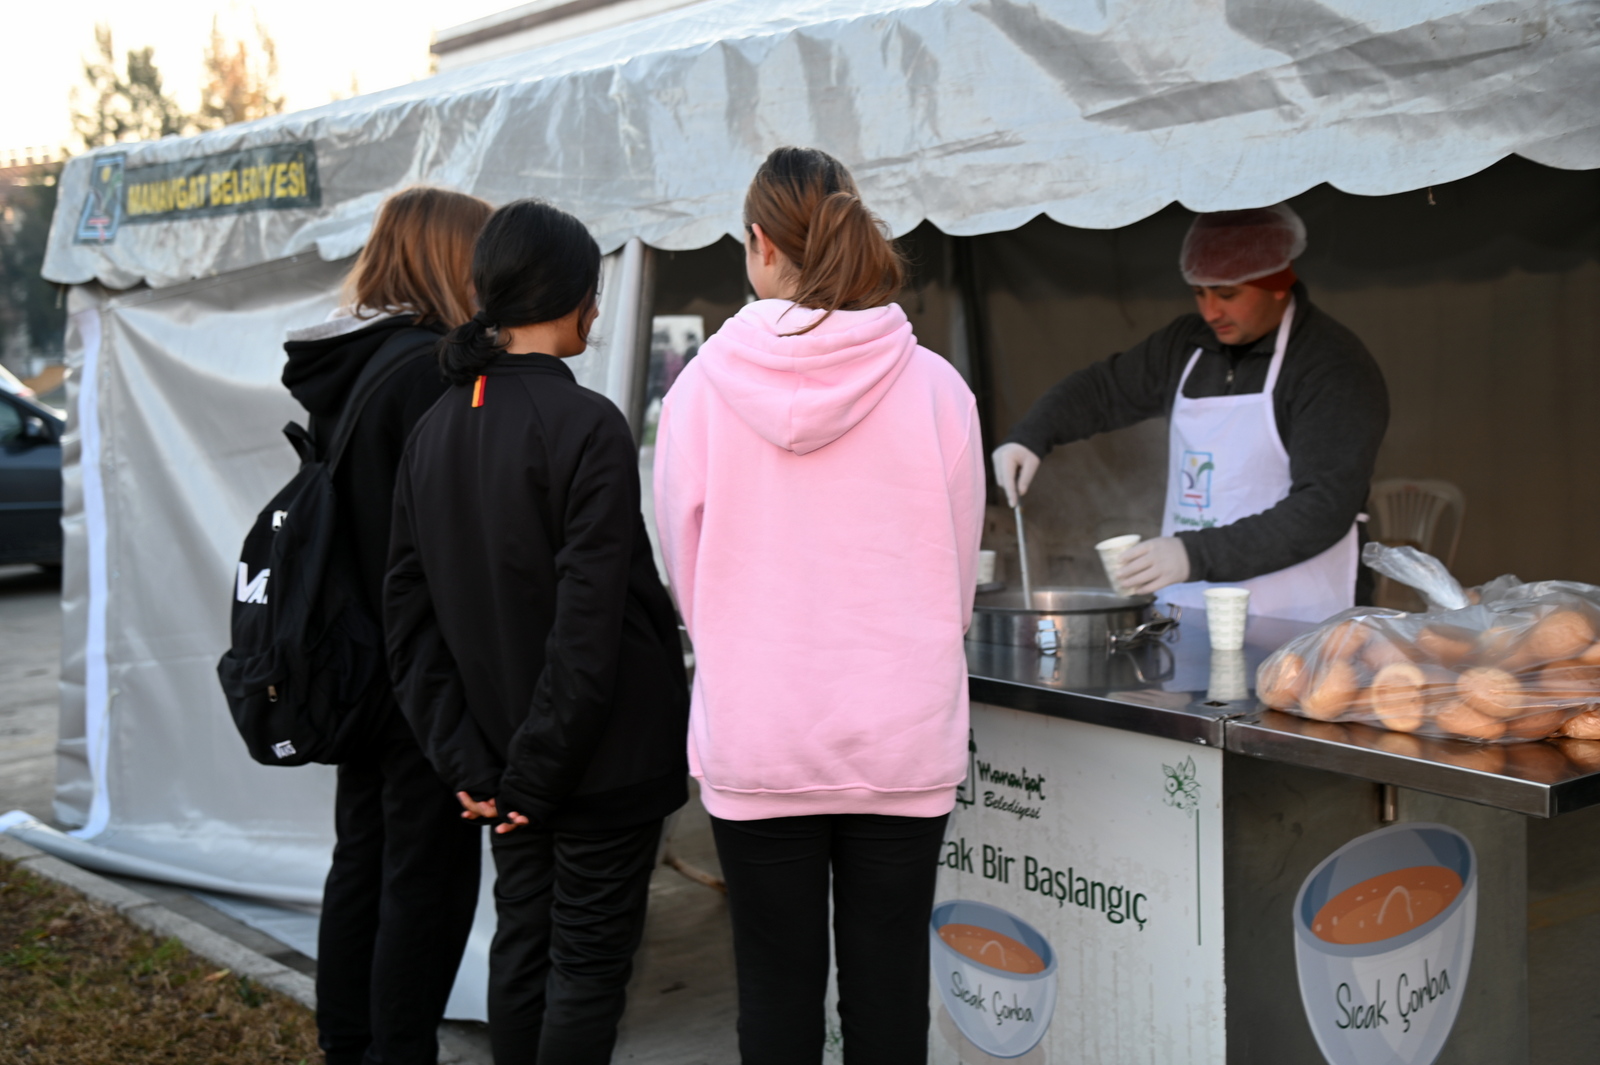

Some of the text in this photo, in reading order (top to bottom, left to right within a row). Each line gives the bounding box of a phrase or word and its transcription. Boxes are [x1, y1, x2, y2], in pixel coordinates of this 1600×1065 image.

[983, 790, 1042, 821] Belediyesi
[982, 843, 1016, 884] Bir
[1024, 855, 1148, 932] Başlangıç
[992, 980, 1035, 1026] Çorba
[1396, 958, 1452, 1034] Çorba
